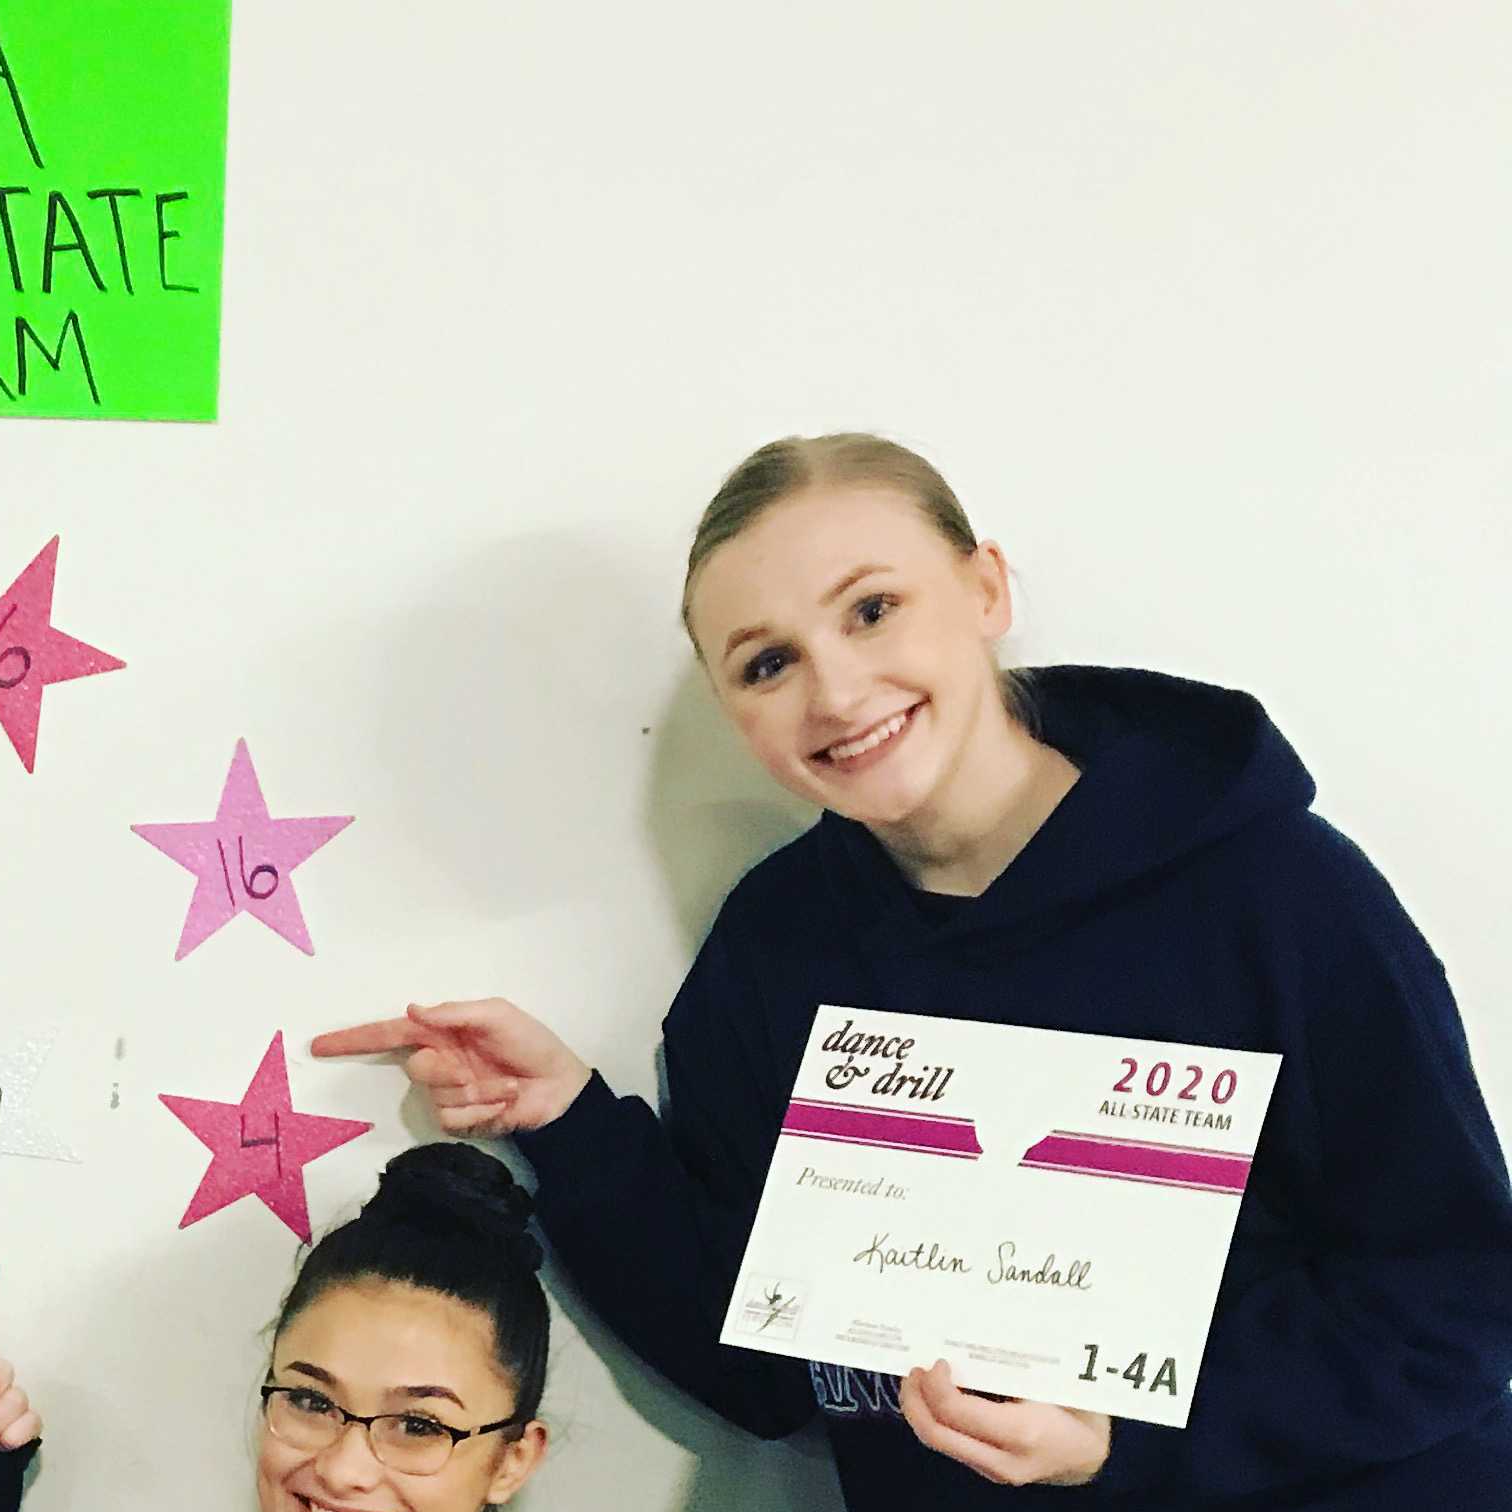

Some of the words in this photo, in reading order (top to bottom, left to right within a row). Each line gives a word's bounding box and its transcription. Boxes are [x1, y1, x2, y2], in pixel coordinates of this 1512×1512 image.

[216, 835, 279, 906] 16
[822, 1021, 915, 1060] dance
[825, 1056, 869, 1090] &
[873, 1061, 954, 1101] drill
[1112, 1058, 1238, 1104] 2020
[1184, 1109, 1234, 1131] TEAM
[240, 1113, 282, 1179] 4
[796, 1167, 880, 1198] Presented
[885, 1181, 911, 1201] to:
[853, 1233, 972, 1274] Kaitlin
[987, 1241, 1093, 1291] Sandall
[1078, 1344, 1179, 1396] 1-4A
